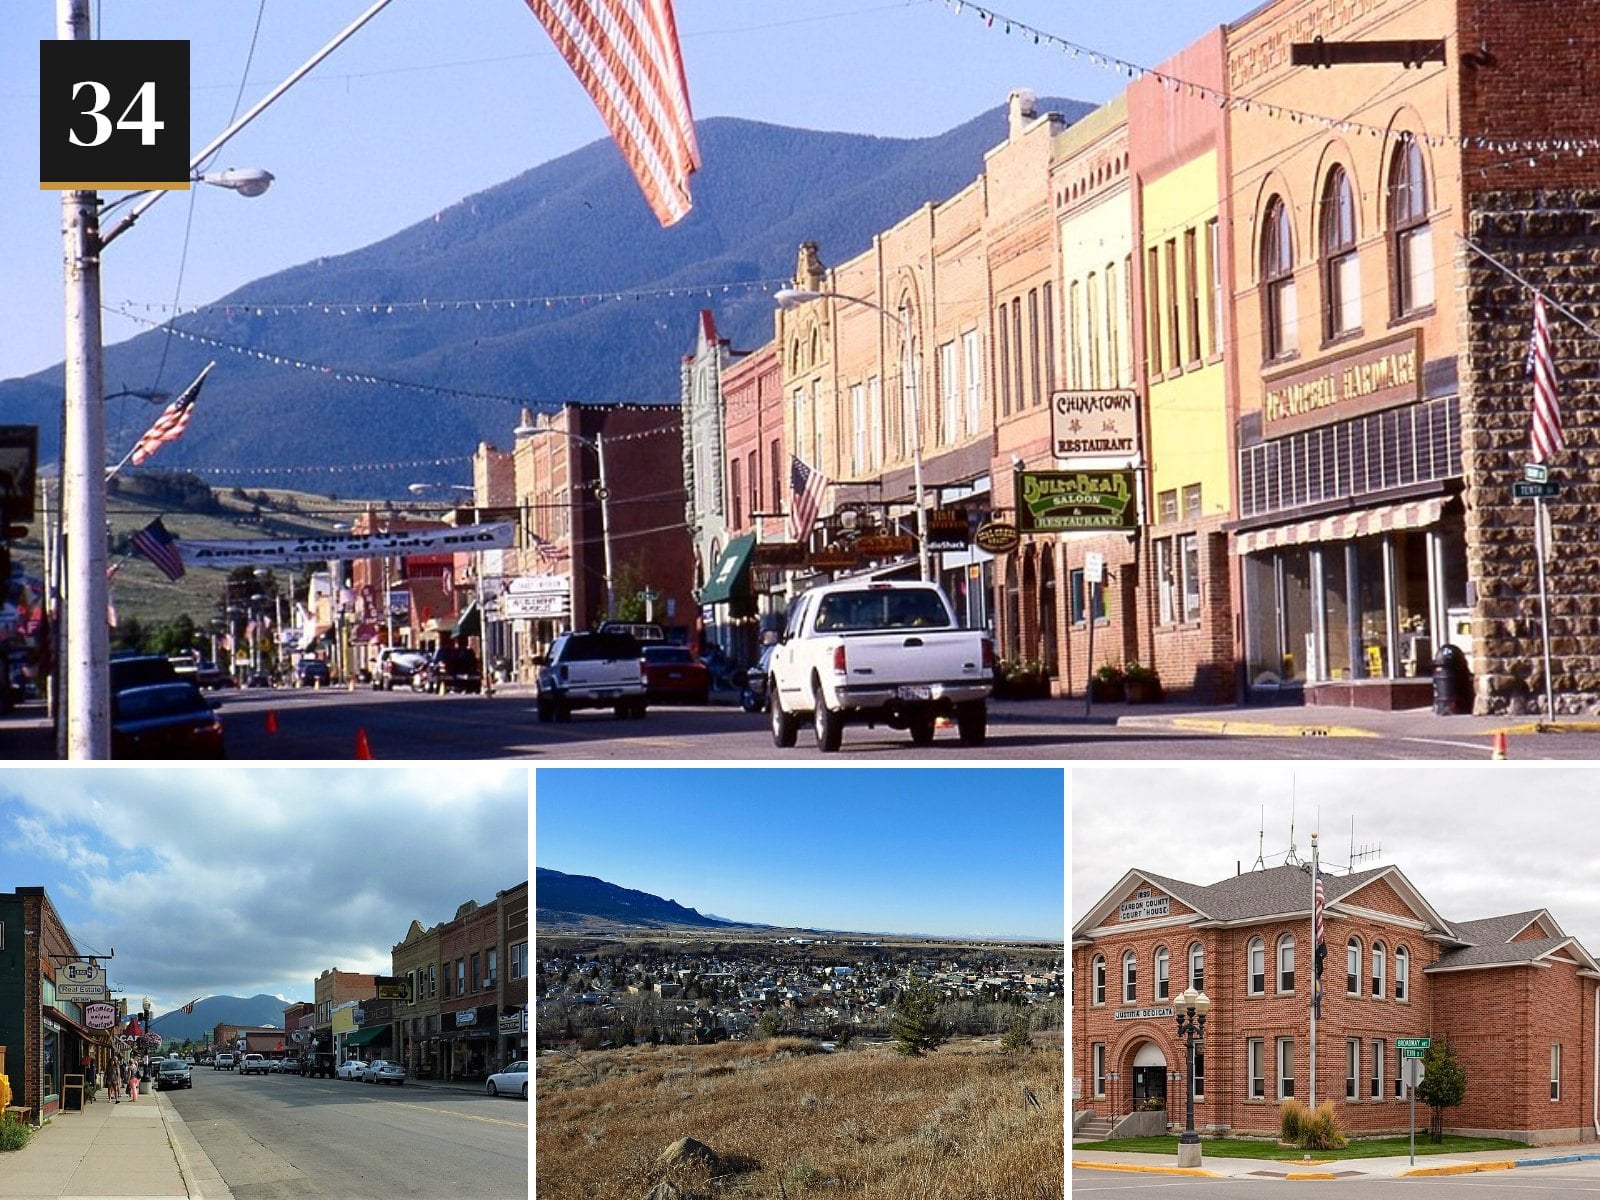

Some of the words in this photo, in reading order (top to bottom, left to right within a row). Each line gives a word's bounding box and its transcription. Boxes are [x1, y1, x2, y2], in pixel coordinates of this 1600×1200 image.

[1057, 395, 1131, 415] CHINATOWN
[1058, 438, 1133, 452] RESTAURANT
[1053, 495, 1101, 505] SALOON
[1037, 516, 1119, 528] RESTAURANT
[294, 544, 335, 553] 4th
[347, 542, 370, 550] of
[384, 538, 434, 549] July
[1121, 902, 1144, 912] CARBON
[1146, 897, 1168, 907] COUNTY
[1122, 910, 1142, 919] COURT
[1146, 906, 1167, 916] HOUSE
[1142, 1009, 1172, 1017] DEDICATA
[120, 1034, 139, 1042] CAF
